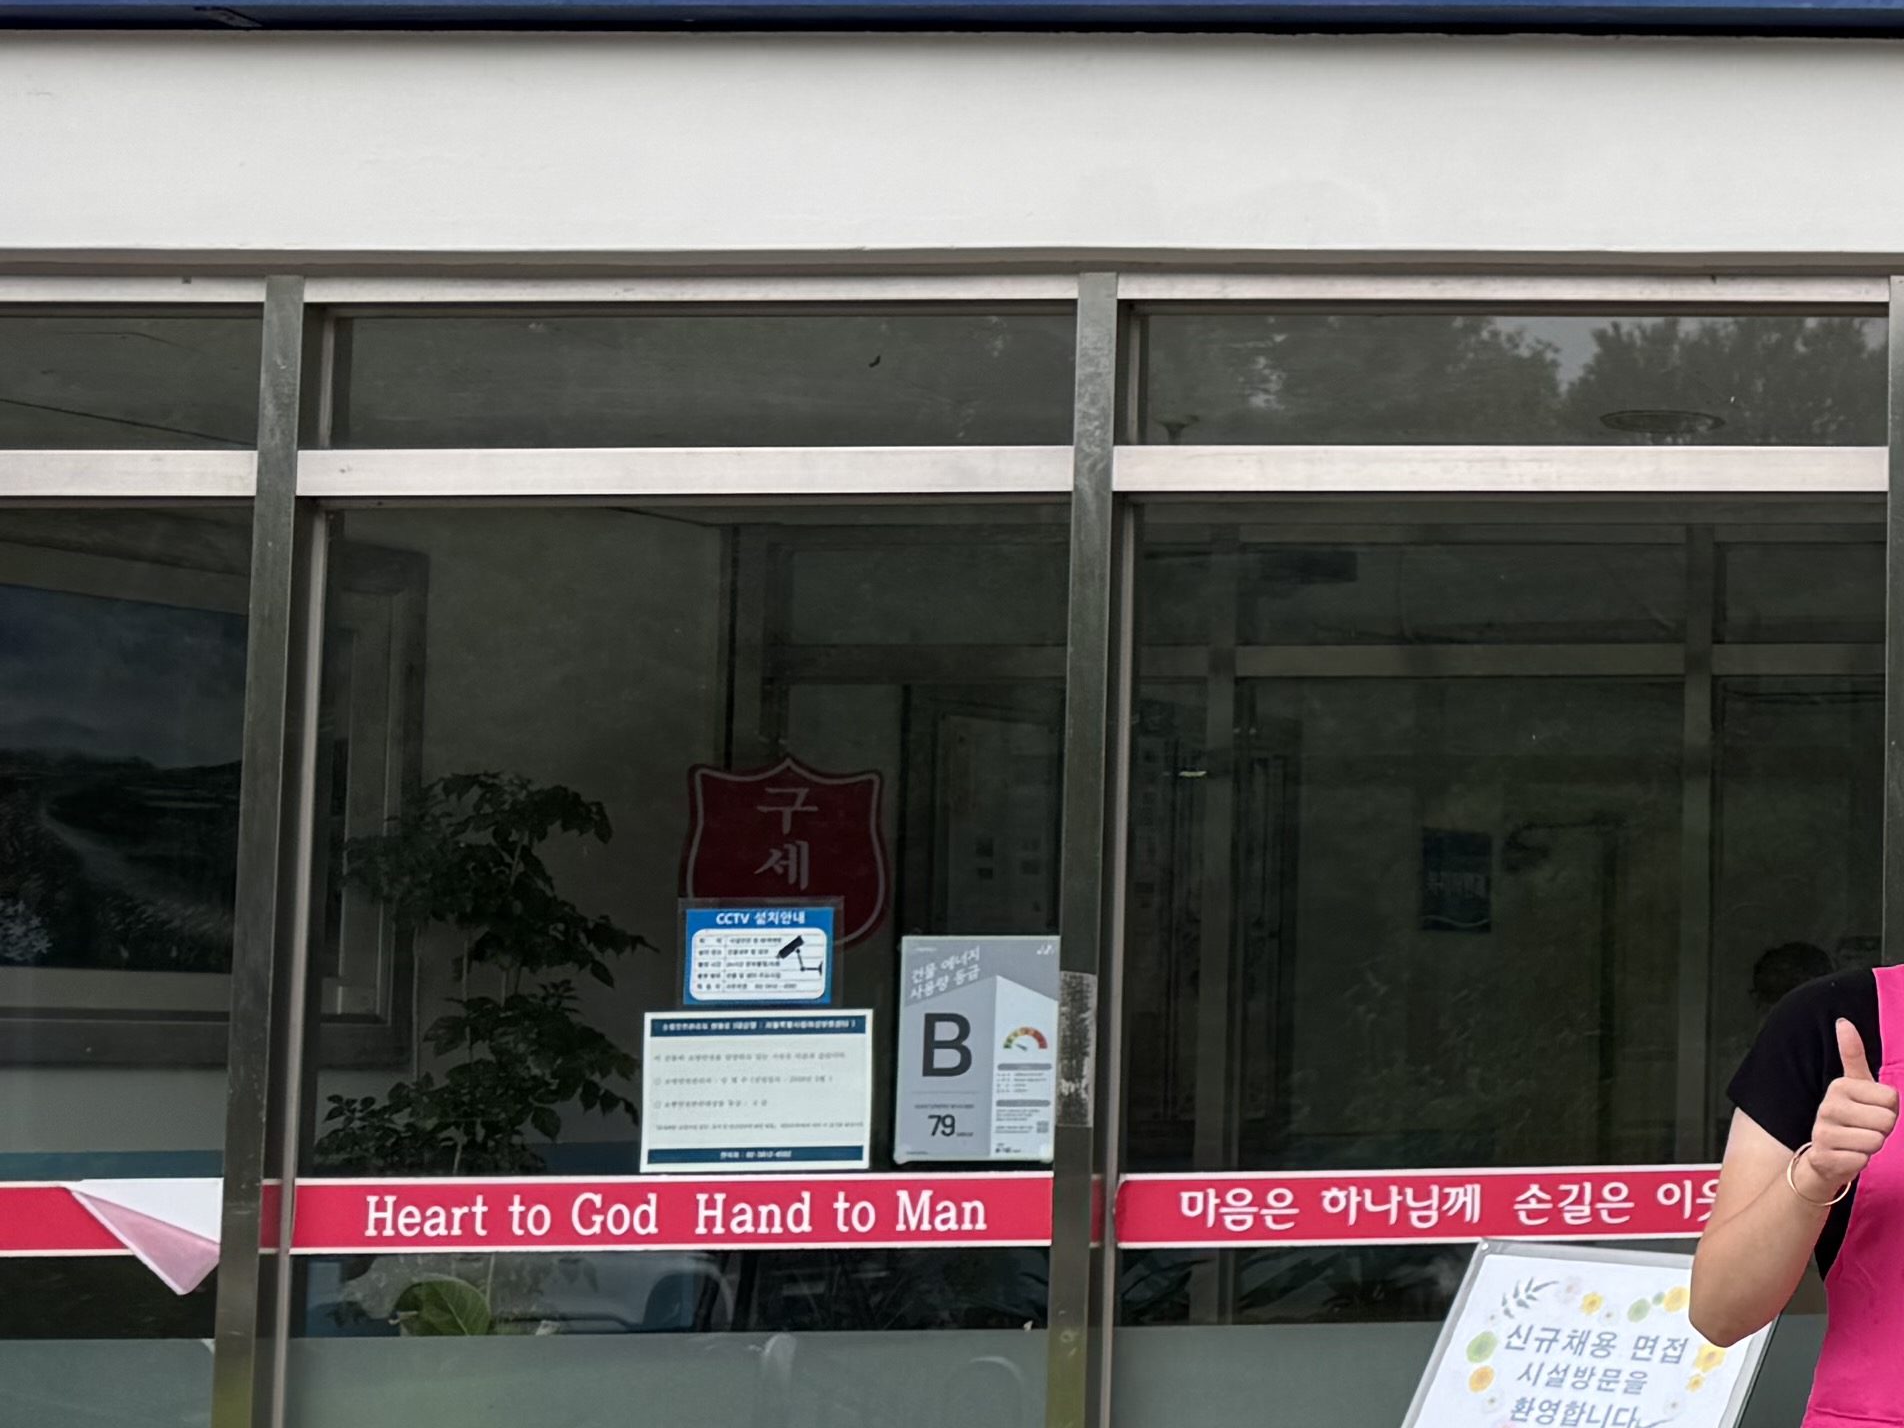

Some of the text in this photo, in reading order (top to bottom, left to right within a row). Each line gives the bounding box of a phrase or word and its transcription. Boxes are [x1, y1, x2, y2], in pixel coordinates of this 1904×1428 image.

[755, 787, 819, 891] 구세
[716, 910, 806, 925] CCTV 설치안내
[910, 963, 981, 1000] 사용량 등급
[911, 945, 981, 984] 건물 에너지
[922, 1013, 972, 1077] B
[928, 1114, 956, 1138] 79
[365, 1190, 988, 1237] Heart to God Hand to Man
[1180, 1187, 1300, 1232] 마음은
[1321, 1184, 1482, 1229] 하나님께
[1513, 1180, 1635, 1225] 손길은
[1504, 1323, 1690, 1365] 신규채용 면접
[1517, 1360, 1649, 1396] 시설방문을
